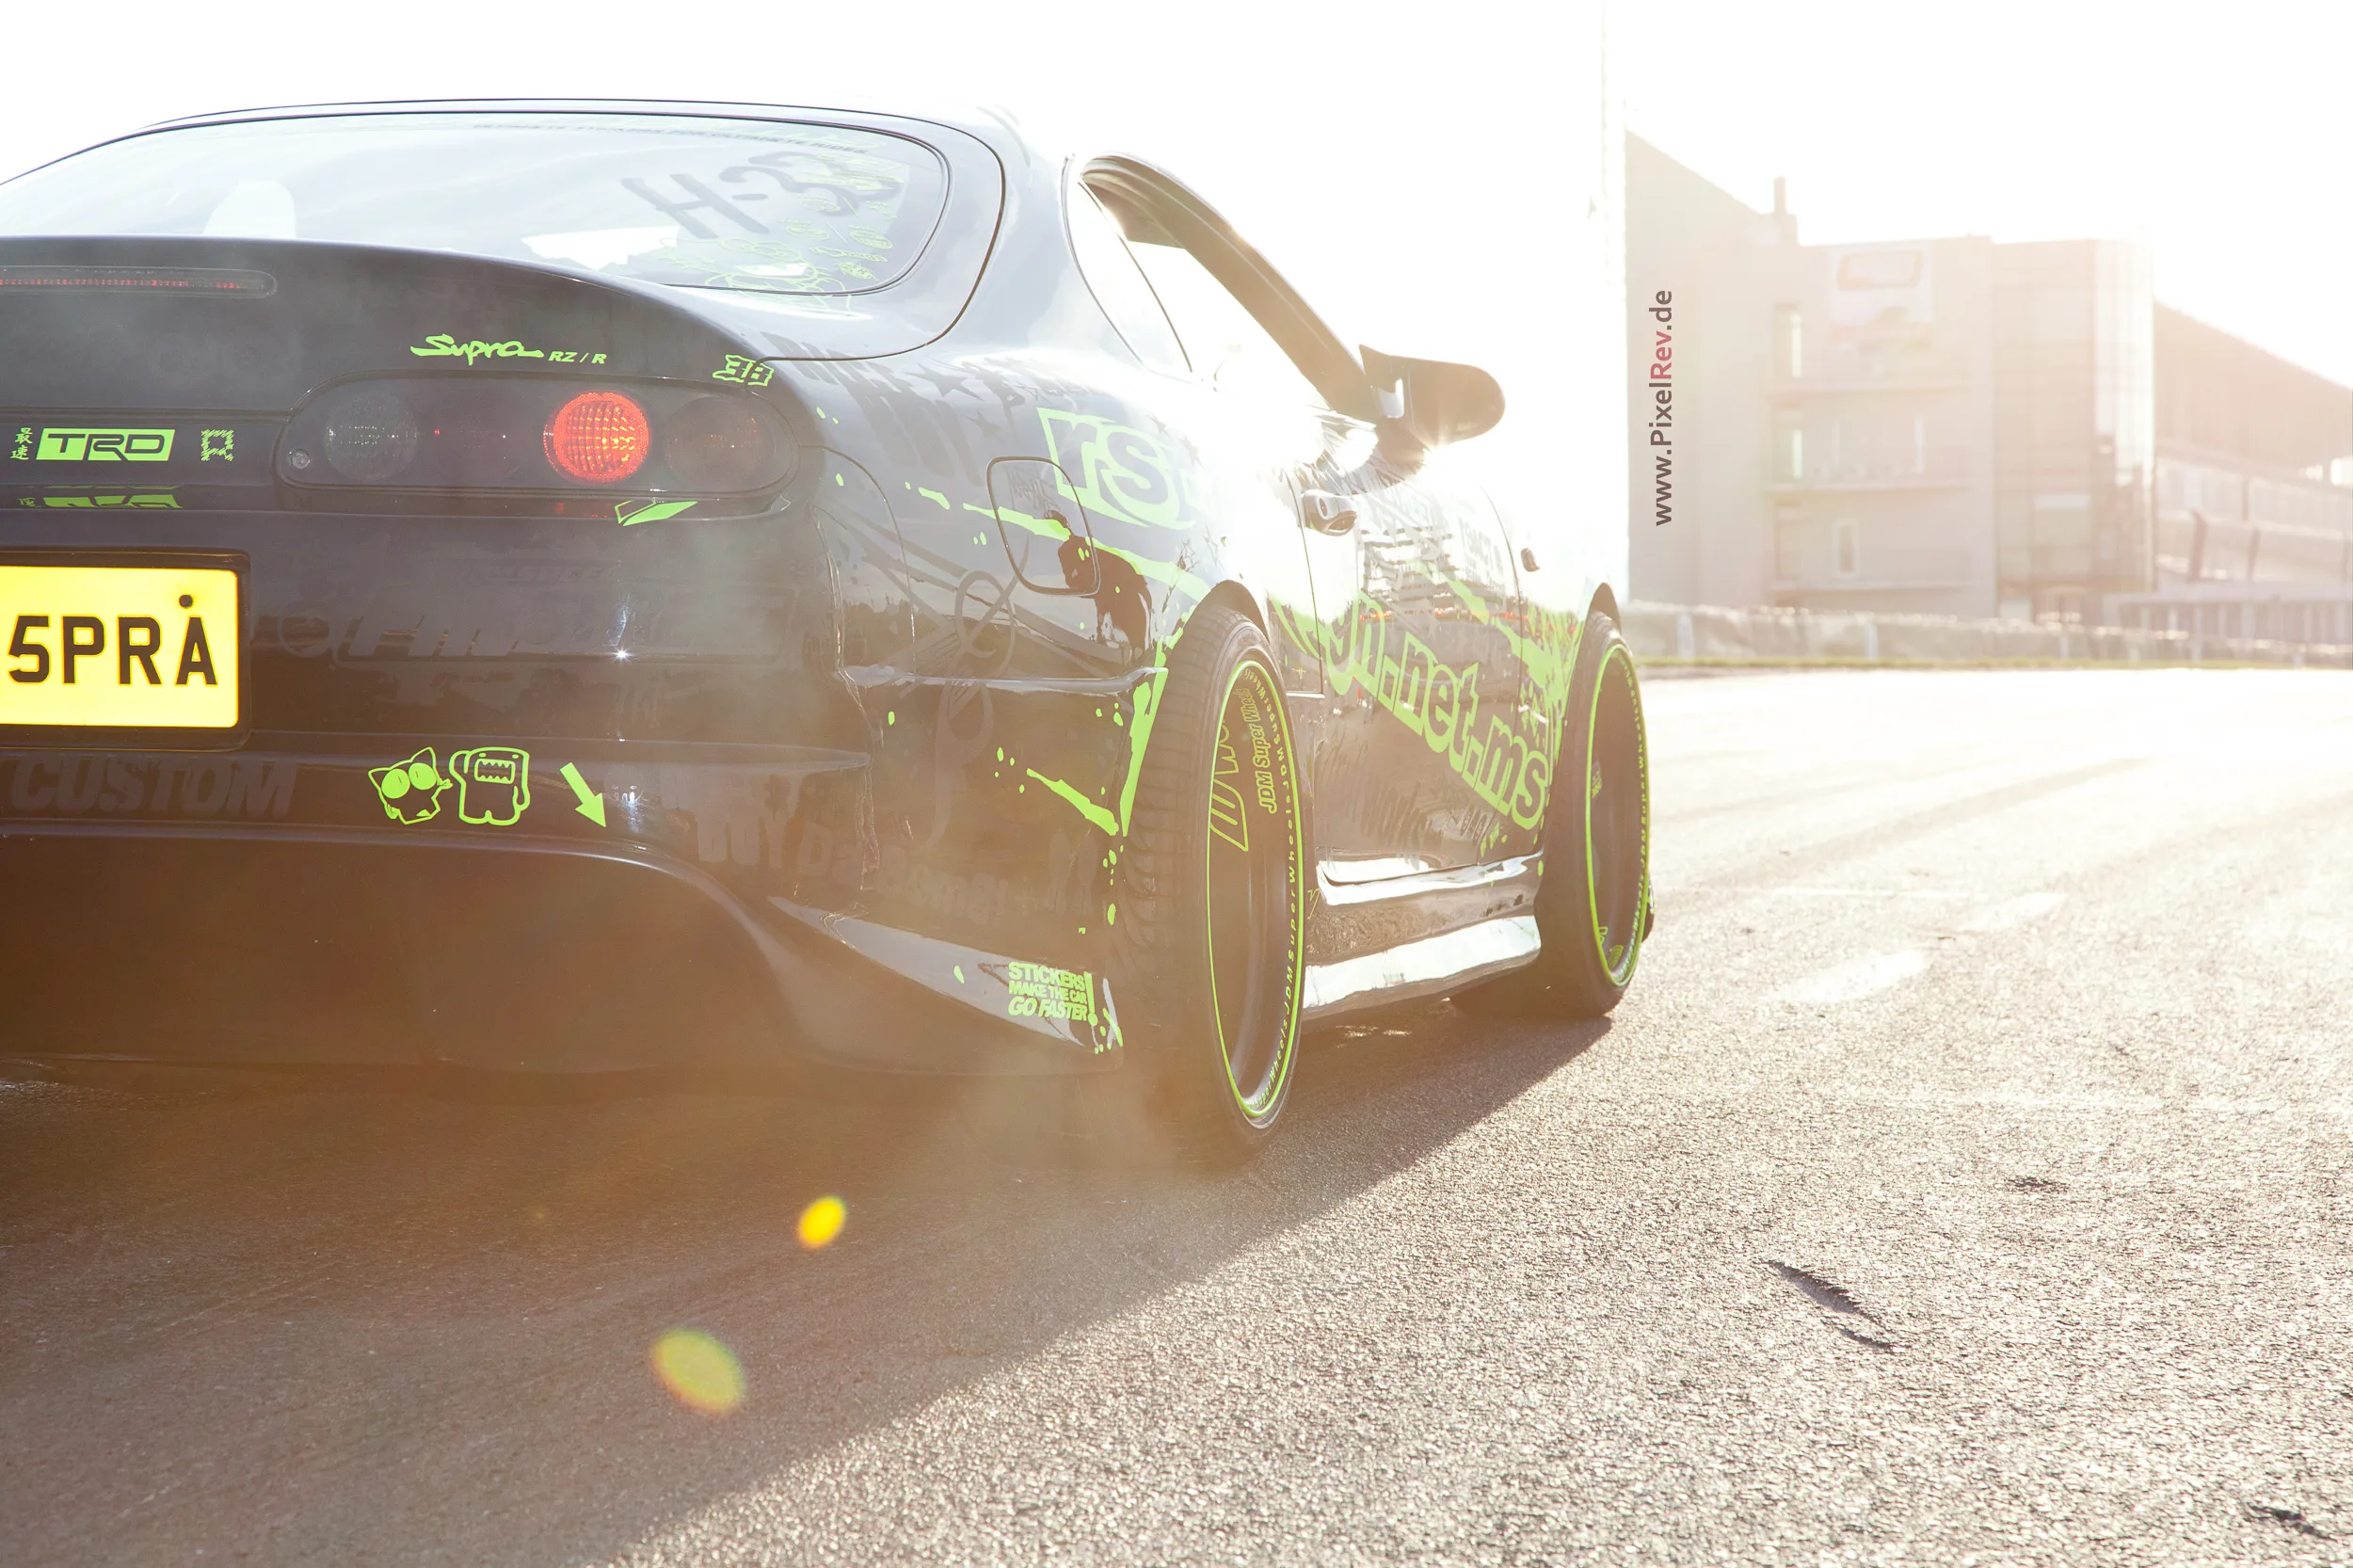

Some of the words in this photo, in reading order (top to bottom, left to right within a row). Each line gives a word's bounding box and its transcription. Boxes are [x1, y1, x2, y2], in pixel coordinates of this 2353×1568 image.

[410, 333, 544, 365] Supra
[40, 430, 173, 461] TRD
[8, 614, 218, 687] 5PRA
[1249, 724, 1272, 770] Super
[9, 752, 297, 818] CUSTOM
[1256, 770, 1278, 814] JDM
[1008, 961, 1085, 991] STICKERS
[1007, 996, 1038, 1016] GO
[1008, 980, 1048, 999] MAKE
[1048, 984, 1069, 1001] THE
[1069, 989, 1088, 1005] CAR
